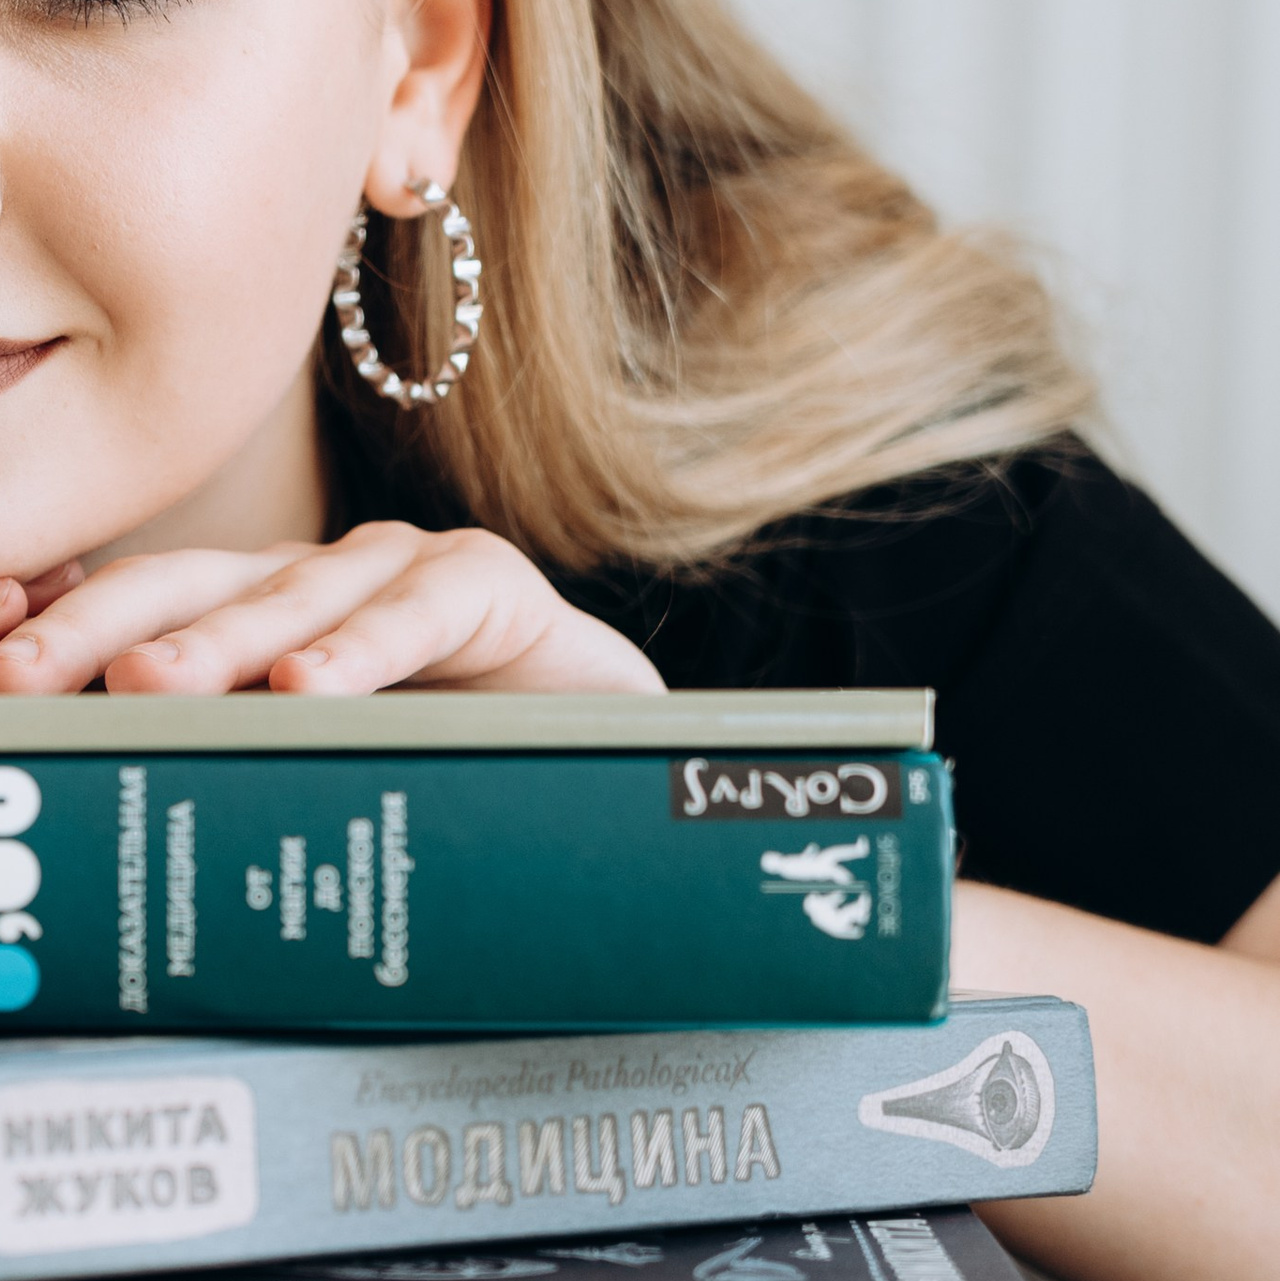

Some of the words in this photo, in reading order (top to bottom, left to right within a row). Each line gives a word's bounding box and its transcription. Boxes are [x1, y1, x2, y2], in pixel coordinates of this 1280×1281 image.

[118, 766, 148, 1013] ДОКАЗАТЕЛЬНАЯ
[166, 799, 197, 978] МЕДИЦИНА
[354, 1057, 555, 1113] Encyclopedia
[4, 1104, 229, 1158] НИКИТА
[331, 1104, 780, 1211] МОДИЦИНА
[17, 1165, 220, 1218] ЖУКОВ
